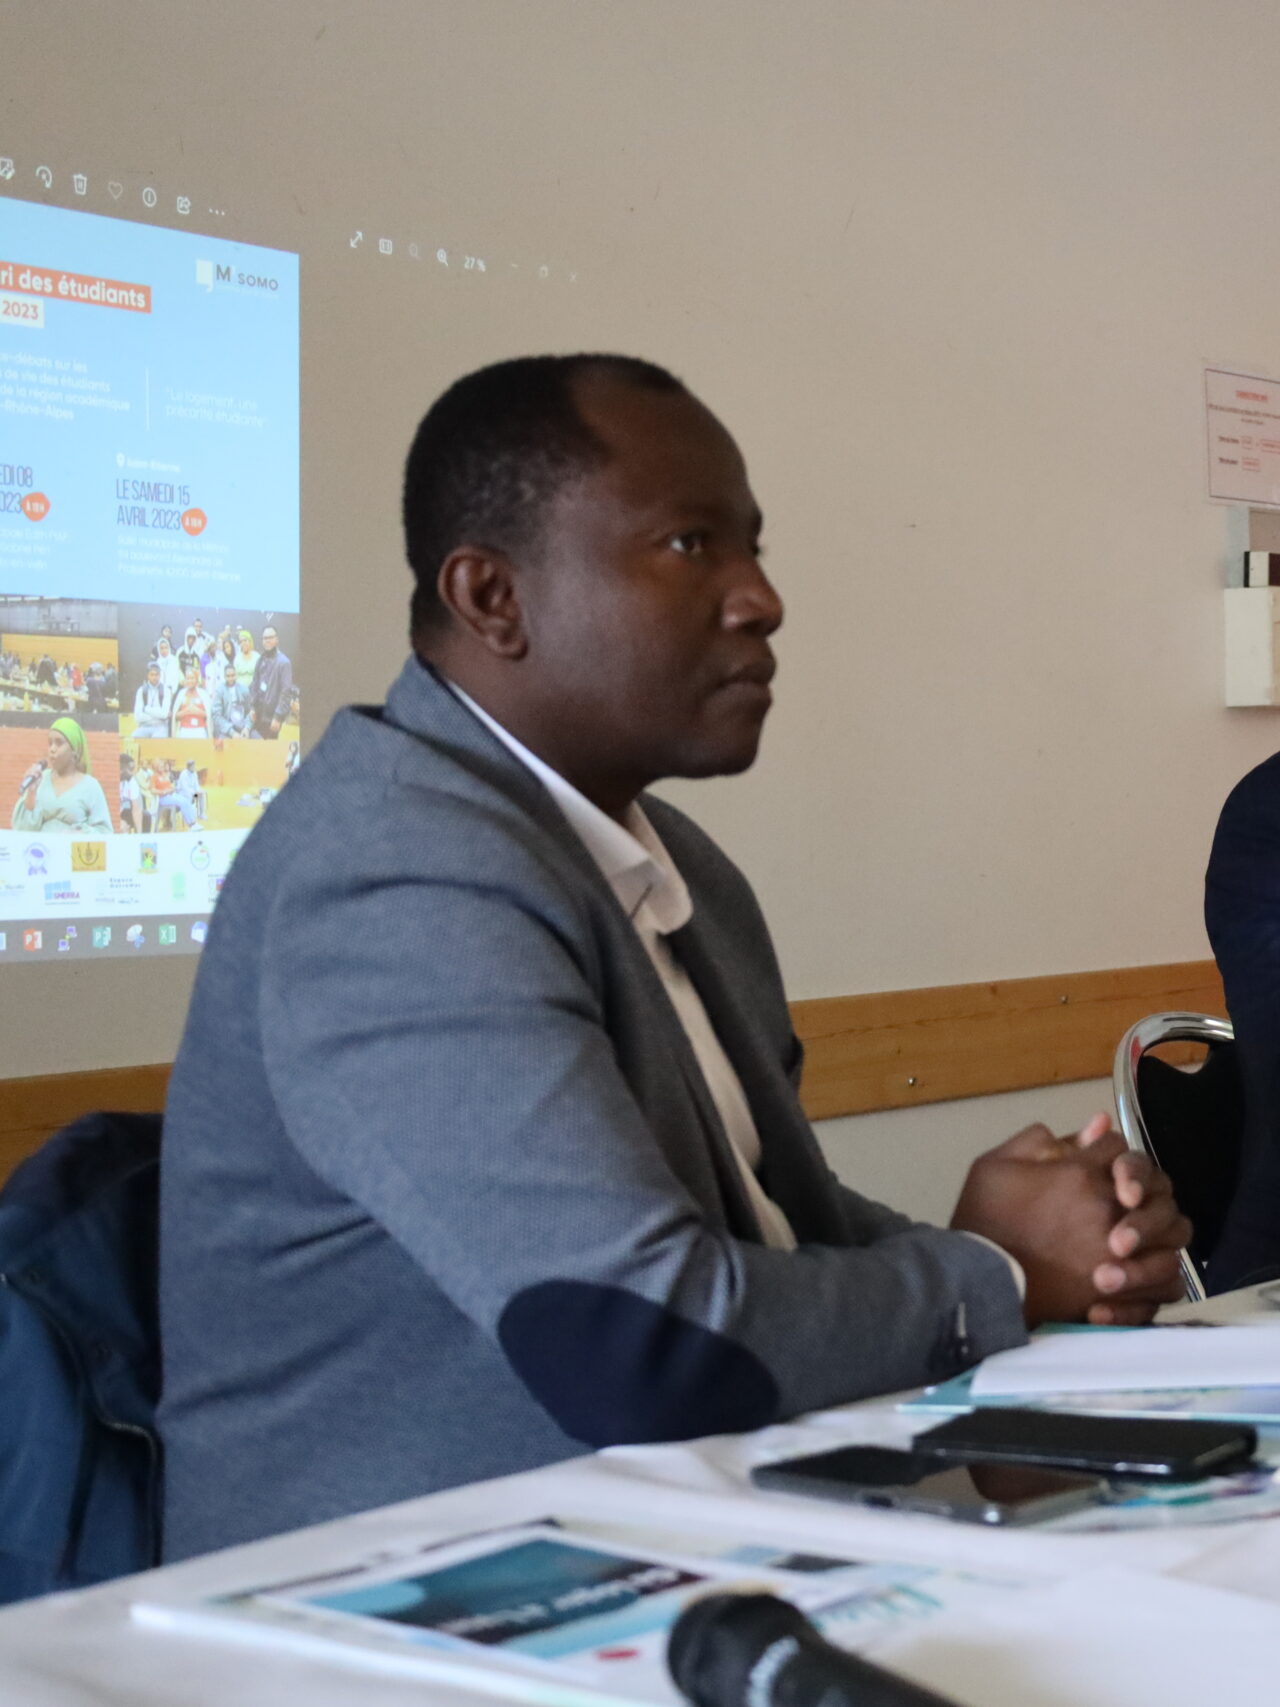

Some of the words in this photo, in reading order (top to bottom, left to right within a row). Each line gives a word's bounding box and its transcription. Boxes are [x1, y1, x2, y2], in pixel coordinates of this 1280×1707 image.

[19, 269, 53, 294] des
[58, 275, 146, 309] étudiants
[2, 300, 39, 321] 2023
[17, 465, 34, 488] 08
[116, 478, 130, 500] LE
[131, 479, 174, 505] SAMEDI
[178, 485, 190, 506] 15
[117, 504, 149, 528] AVRIL
[151, 508, 181, 531] 2023
